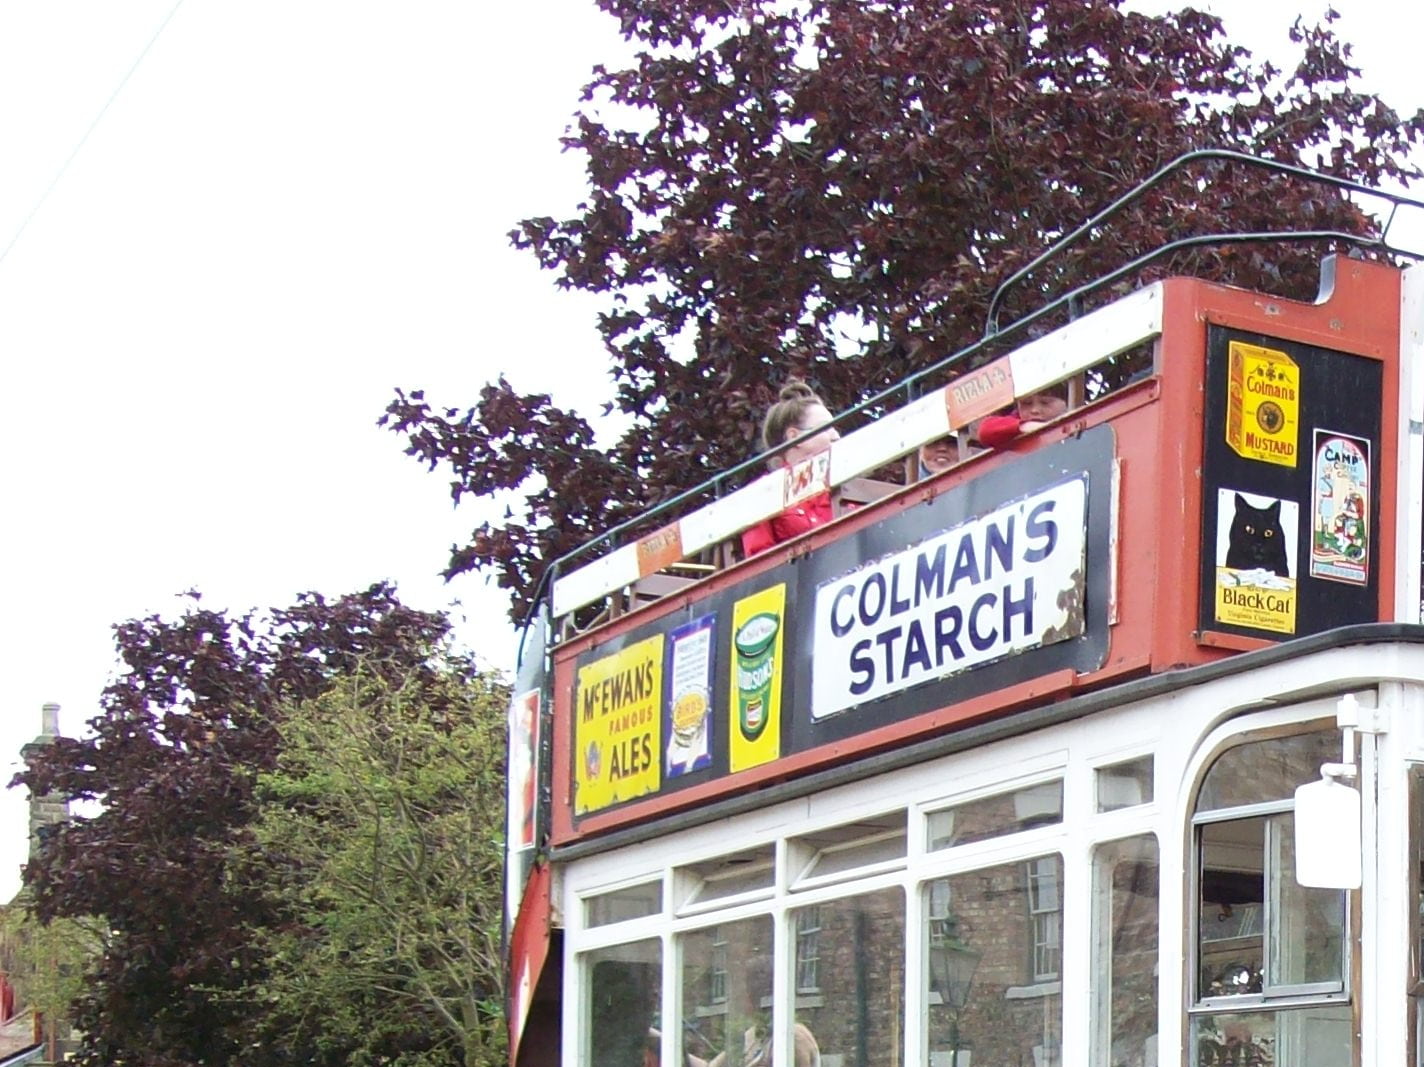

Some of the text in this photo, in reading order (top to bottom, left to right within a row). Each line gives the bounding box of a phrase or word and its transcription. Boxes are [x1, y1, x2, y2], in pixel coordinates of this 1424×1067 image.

[1245, 431, 1295, 456] MUSTARD
[1324, 446, 1359, 465] CAMP
[830, 499, 1059, 639] COLMAN'S
[1223, 587, 1264, 610] Black
[1266, 594, 1293, 614] Cat
[848, 576, 1034, 696] STARCH
[609, 705, 653, 736] FAMOUS
[609, 732, 652, 783] ALES
